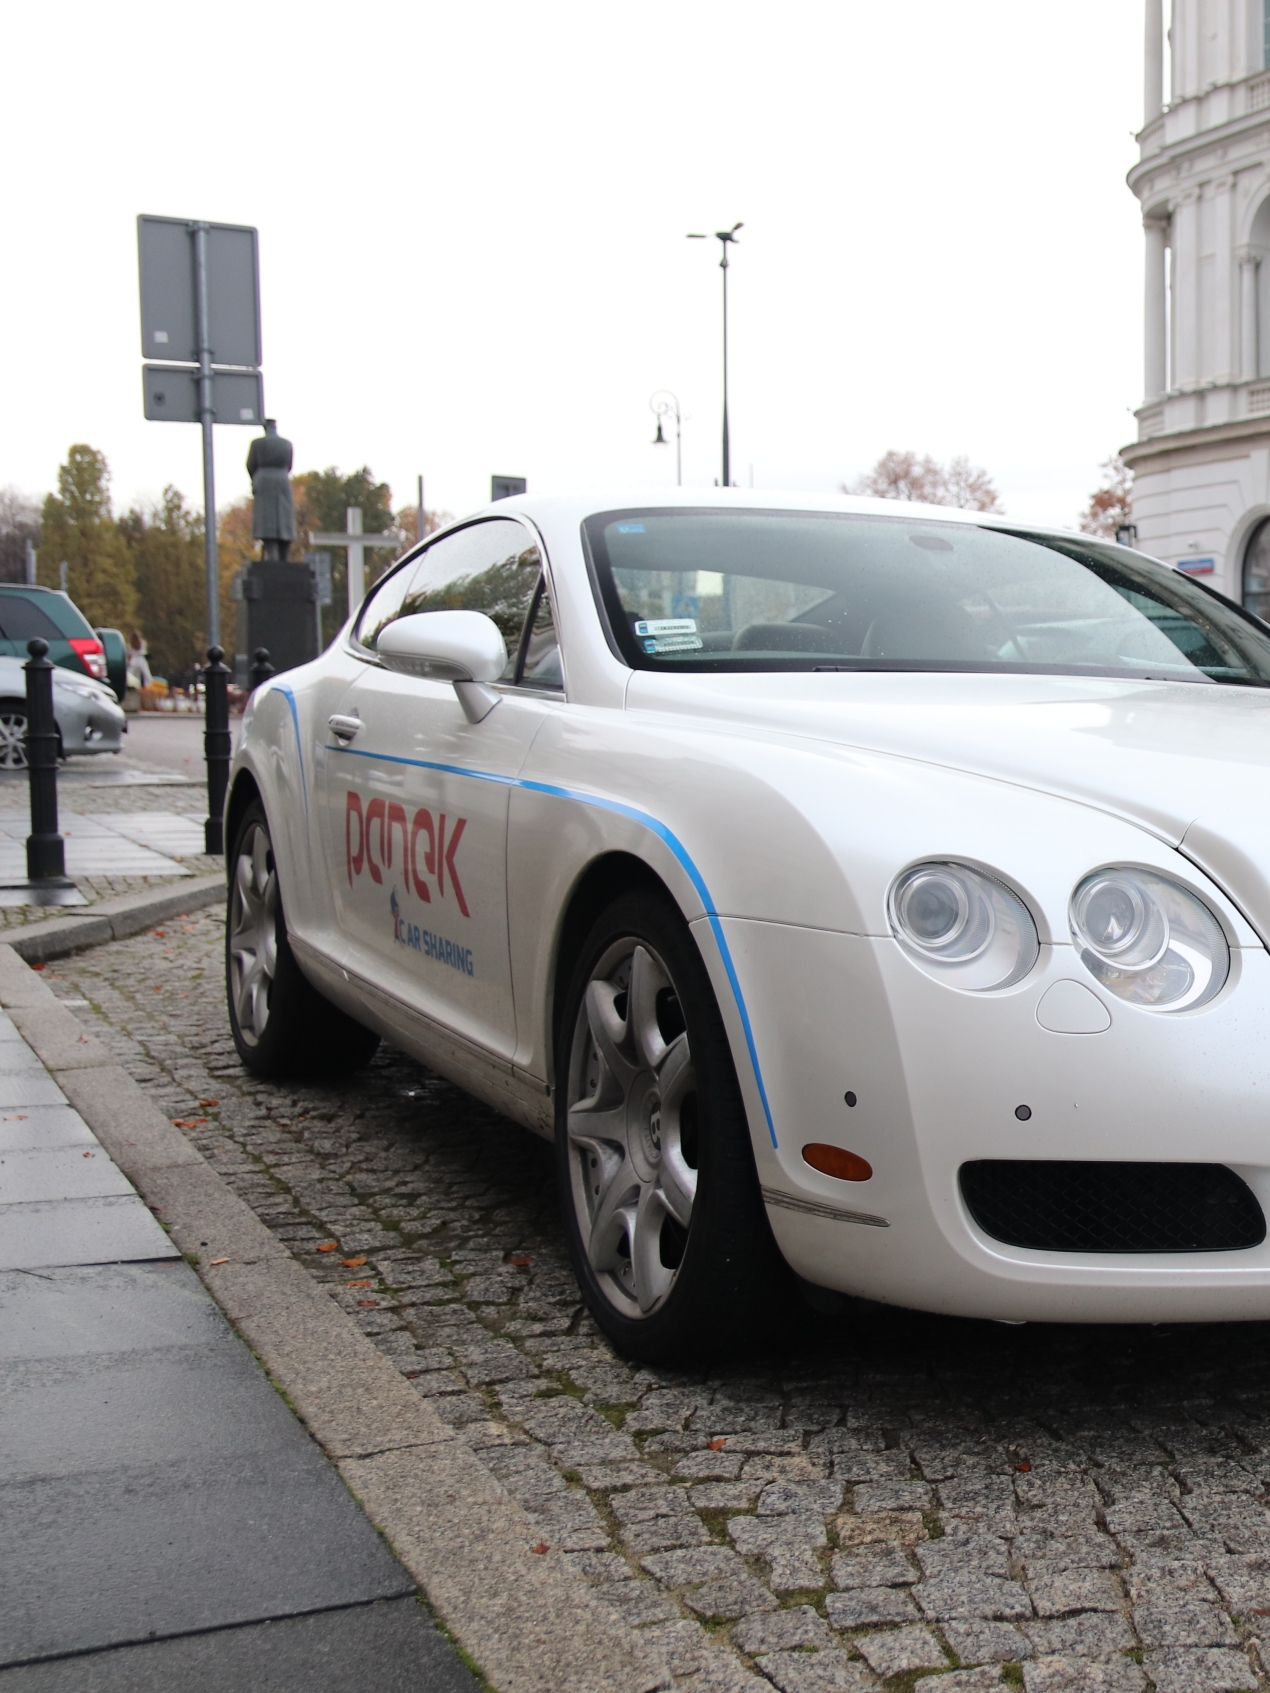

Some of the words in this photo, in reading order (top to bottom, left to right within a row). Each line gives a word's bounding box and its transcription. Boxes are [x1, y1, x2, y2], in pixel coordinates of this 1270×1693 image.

[346, 790, 471, 918] panek
[398, 918, 422, 951] CAR
[423, 930, 474, 977] SHARING
